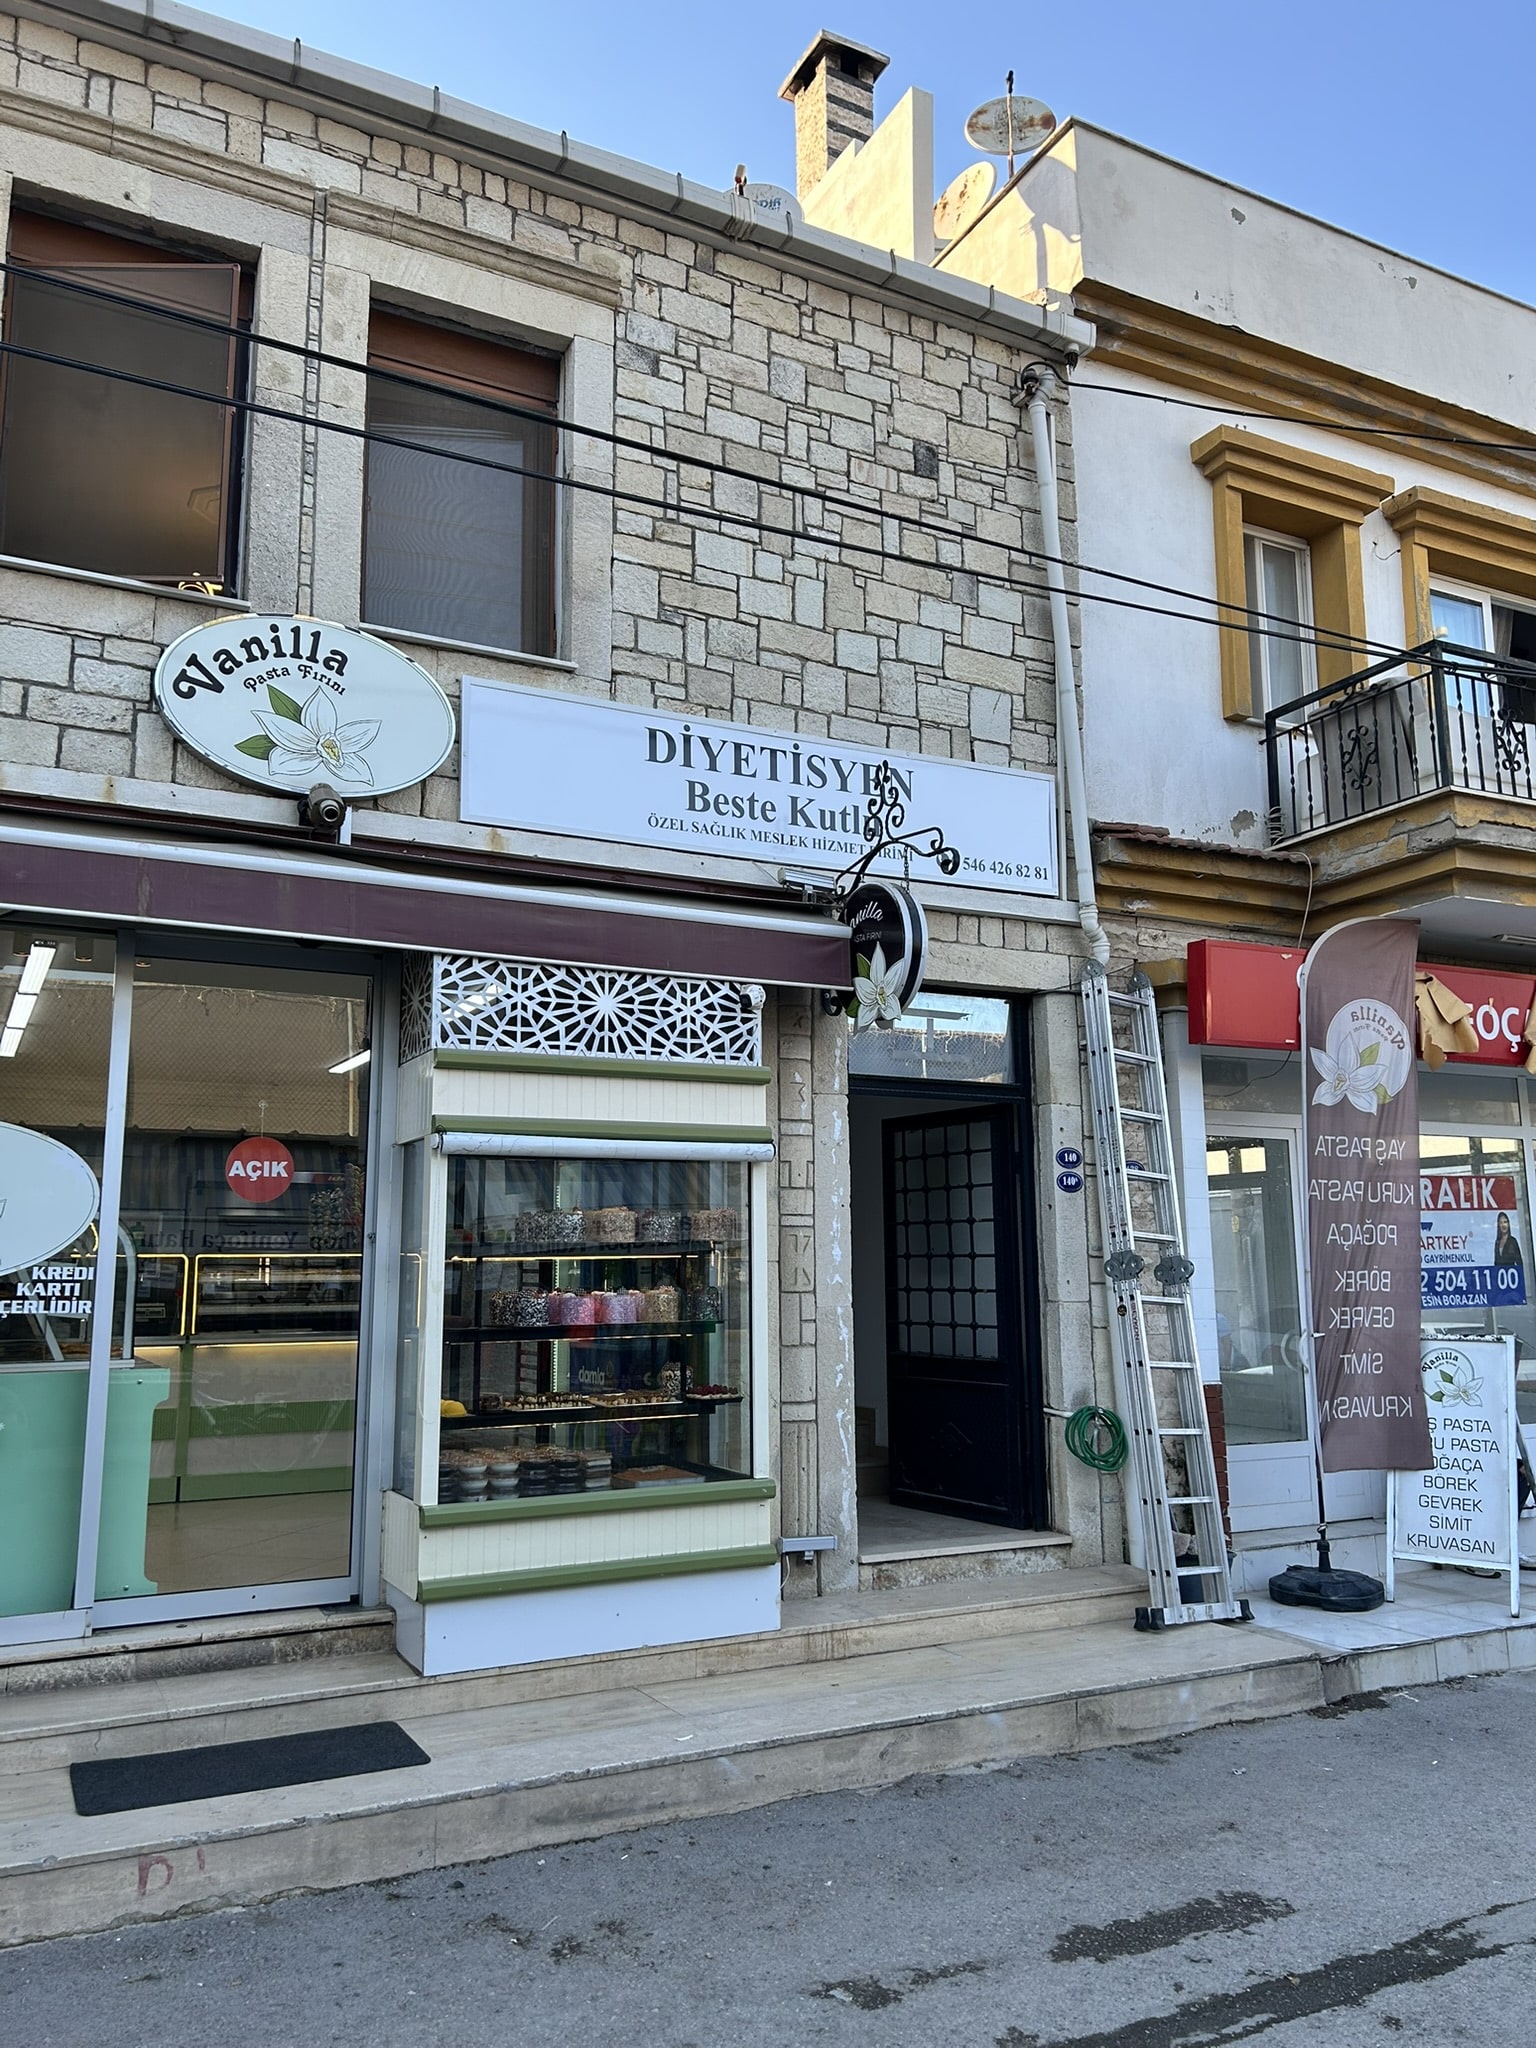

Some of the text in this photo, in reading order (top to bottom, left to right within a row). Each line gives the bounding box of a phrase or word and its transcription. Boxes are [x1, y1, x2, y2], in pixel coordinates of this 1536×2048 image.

[173, 624, 349, 699] Vanilla
[243, 663, 347, 696] Pasta Fırını
[644, 724, 914, 802] DİYETİSYEN
[686, 779, 777, 822] Beste
[647, 813, 688, 832] ÖZEL
[690, 820, 747, 841] SAĞLIK
[750, 829, 808, 849] MESLEK
[812, 836, 866, 855] HİZMET
[963, 857, 1049, 881] 546 426 82 81
[228, 1160, 289, 1181] AÇIK
[1420, 1177, 1498, 1209] RALIK
[16, 1282, 81, 1297] KARTI
[1434, 1270, 1468, 1293] 504
[1472, 1269, 1492, 1290] 11
[1497, 1268, 1519, 1290] 00
[0, 1296, 92, 1319] ÇERLİDİR
[1443, 1293, 1488, 1306] BORAZAN
[1421, 1351, 1459, 1372] Vanilla
[1443, 1418, 1492, 1434] PASTA
[1451, 1438, 1501, 1454] PASTA
[1423, 1472, 1478, 1492] BÖREK
[1418, 1494, 1483, 1513] GEVREK
[1429, 1515, 1473, 1532] SİMİT
[1407, 1533, 1495, 1555] KRUVASAN
